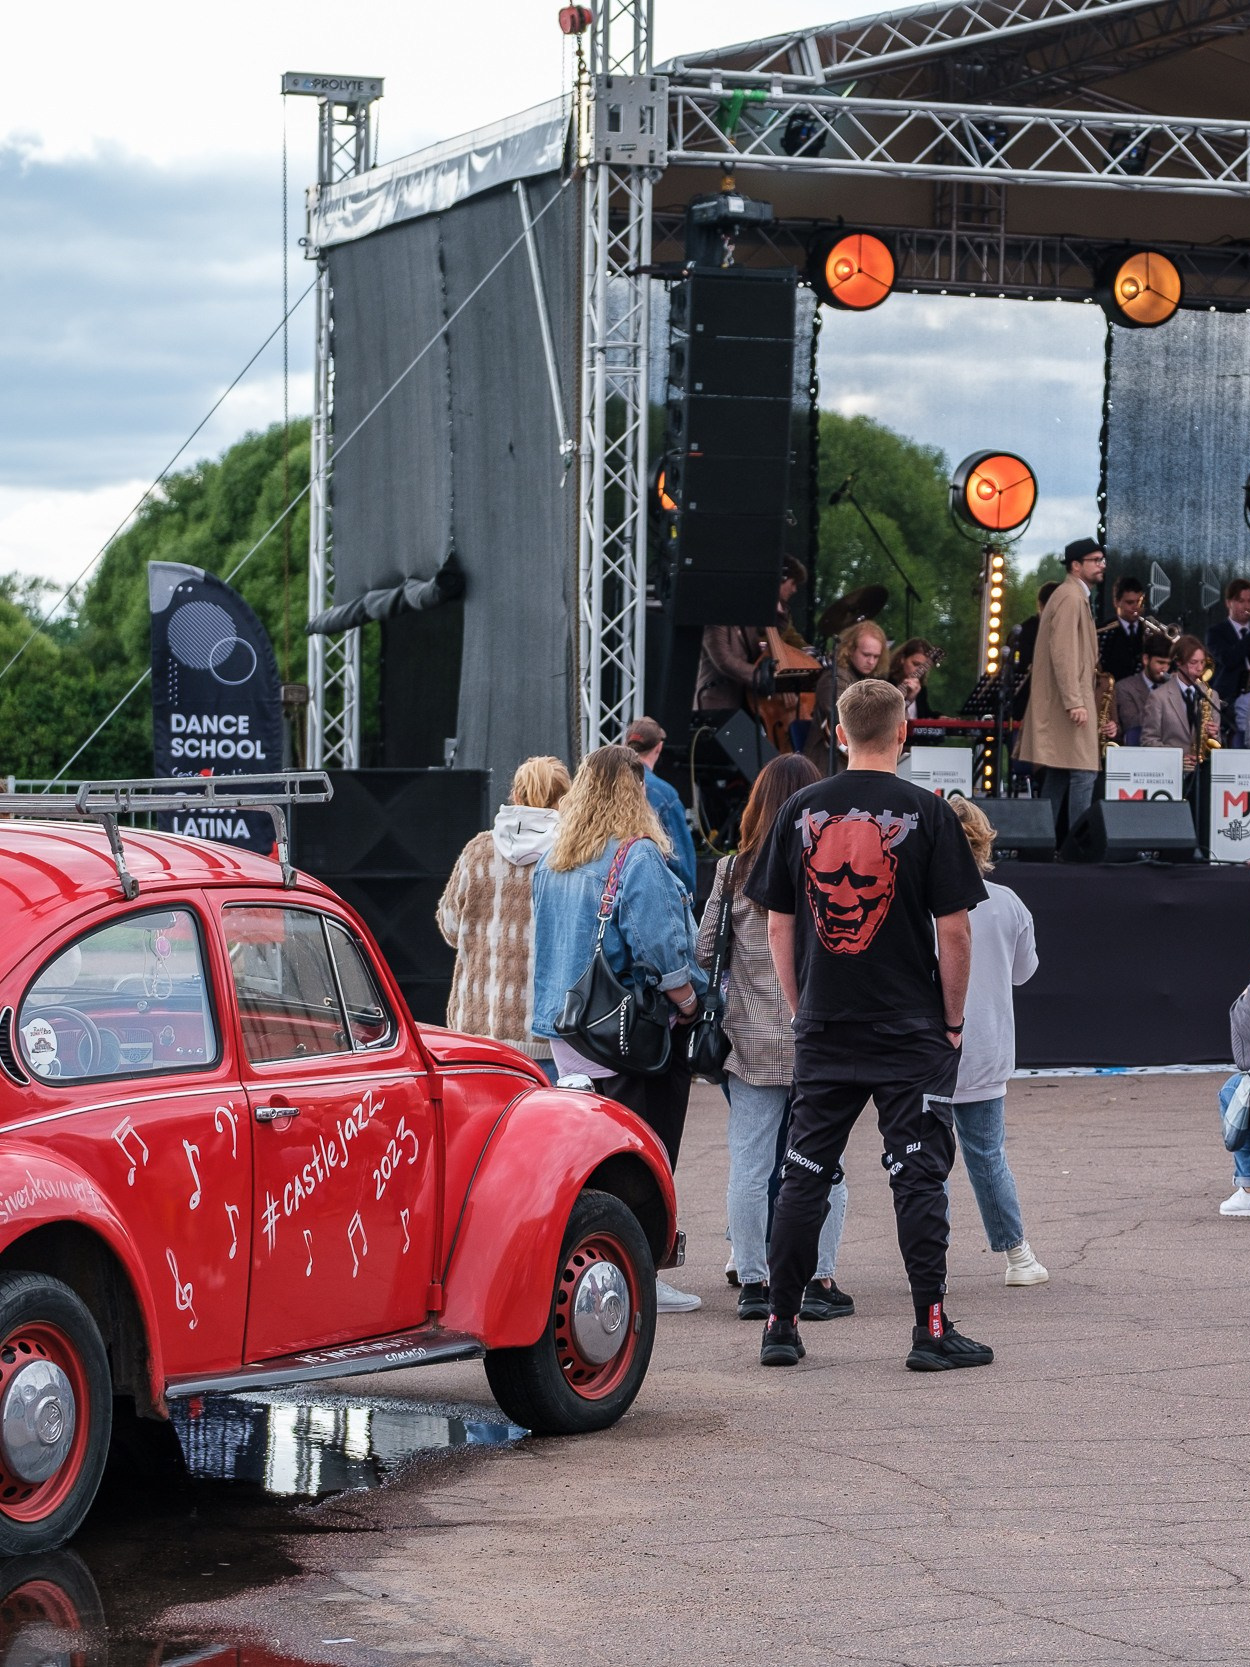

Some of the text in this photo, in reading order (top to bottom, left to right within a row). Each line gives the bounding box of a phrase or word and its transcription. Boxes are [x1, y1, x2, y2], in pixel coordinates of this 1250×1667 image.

[313, 79, 364, 90] PROLYTE
[171, 713, 250, 735] DANCE
[171, 737, 267, 760] SCHOOL
[173, 816, 251, 839] LATINA
[373, 1116, 419, 1200] 2023
